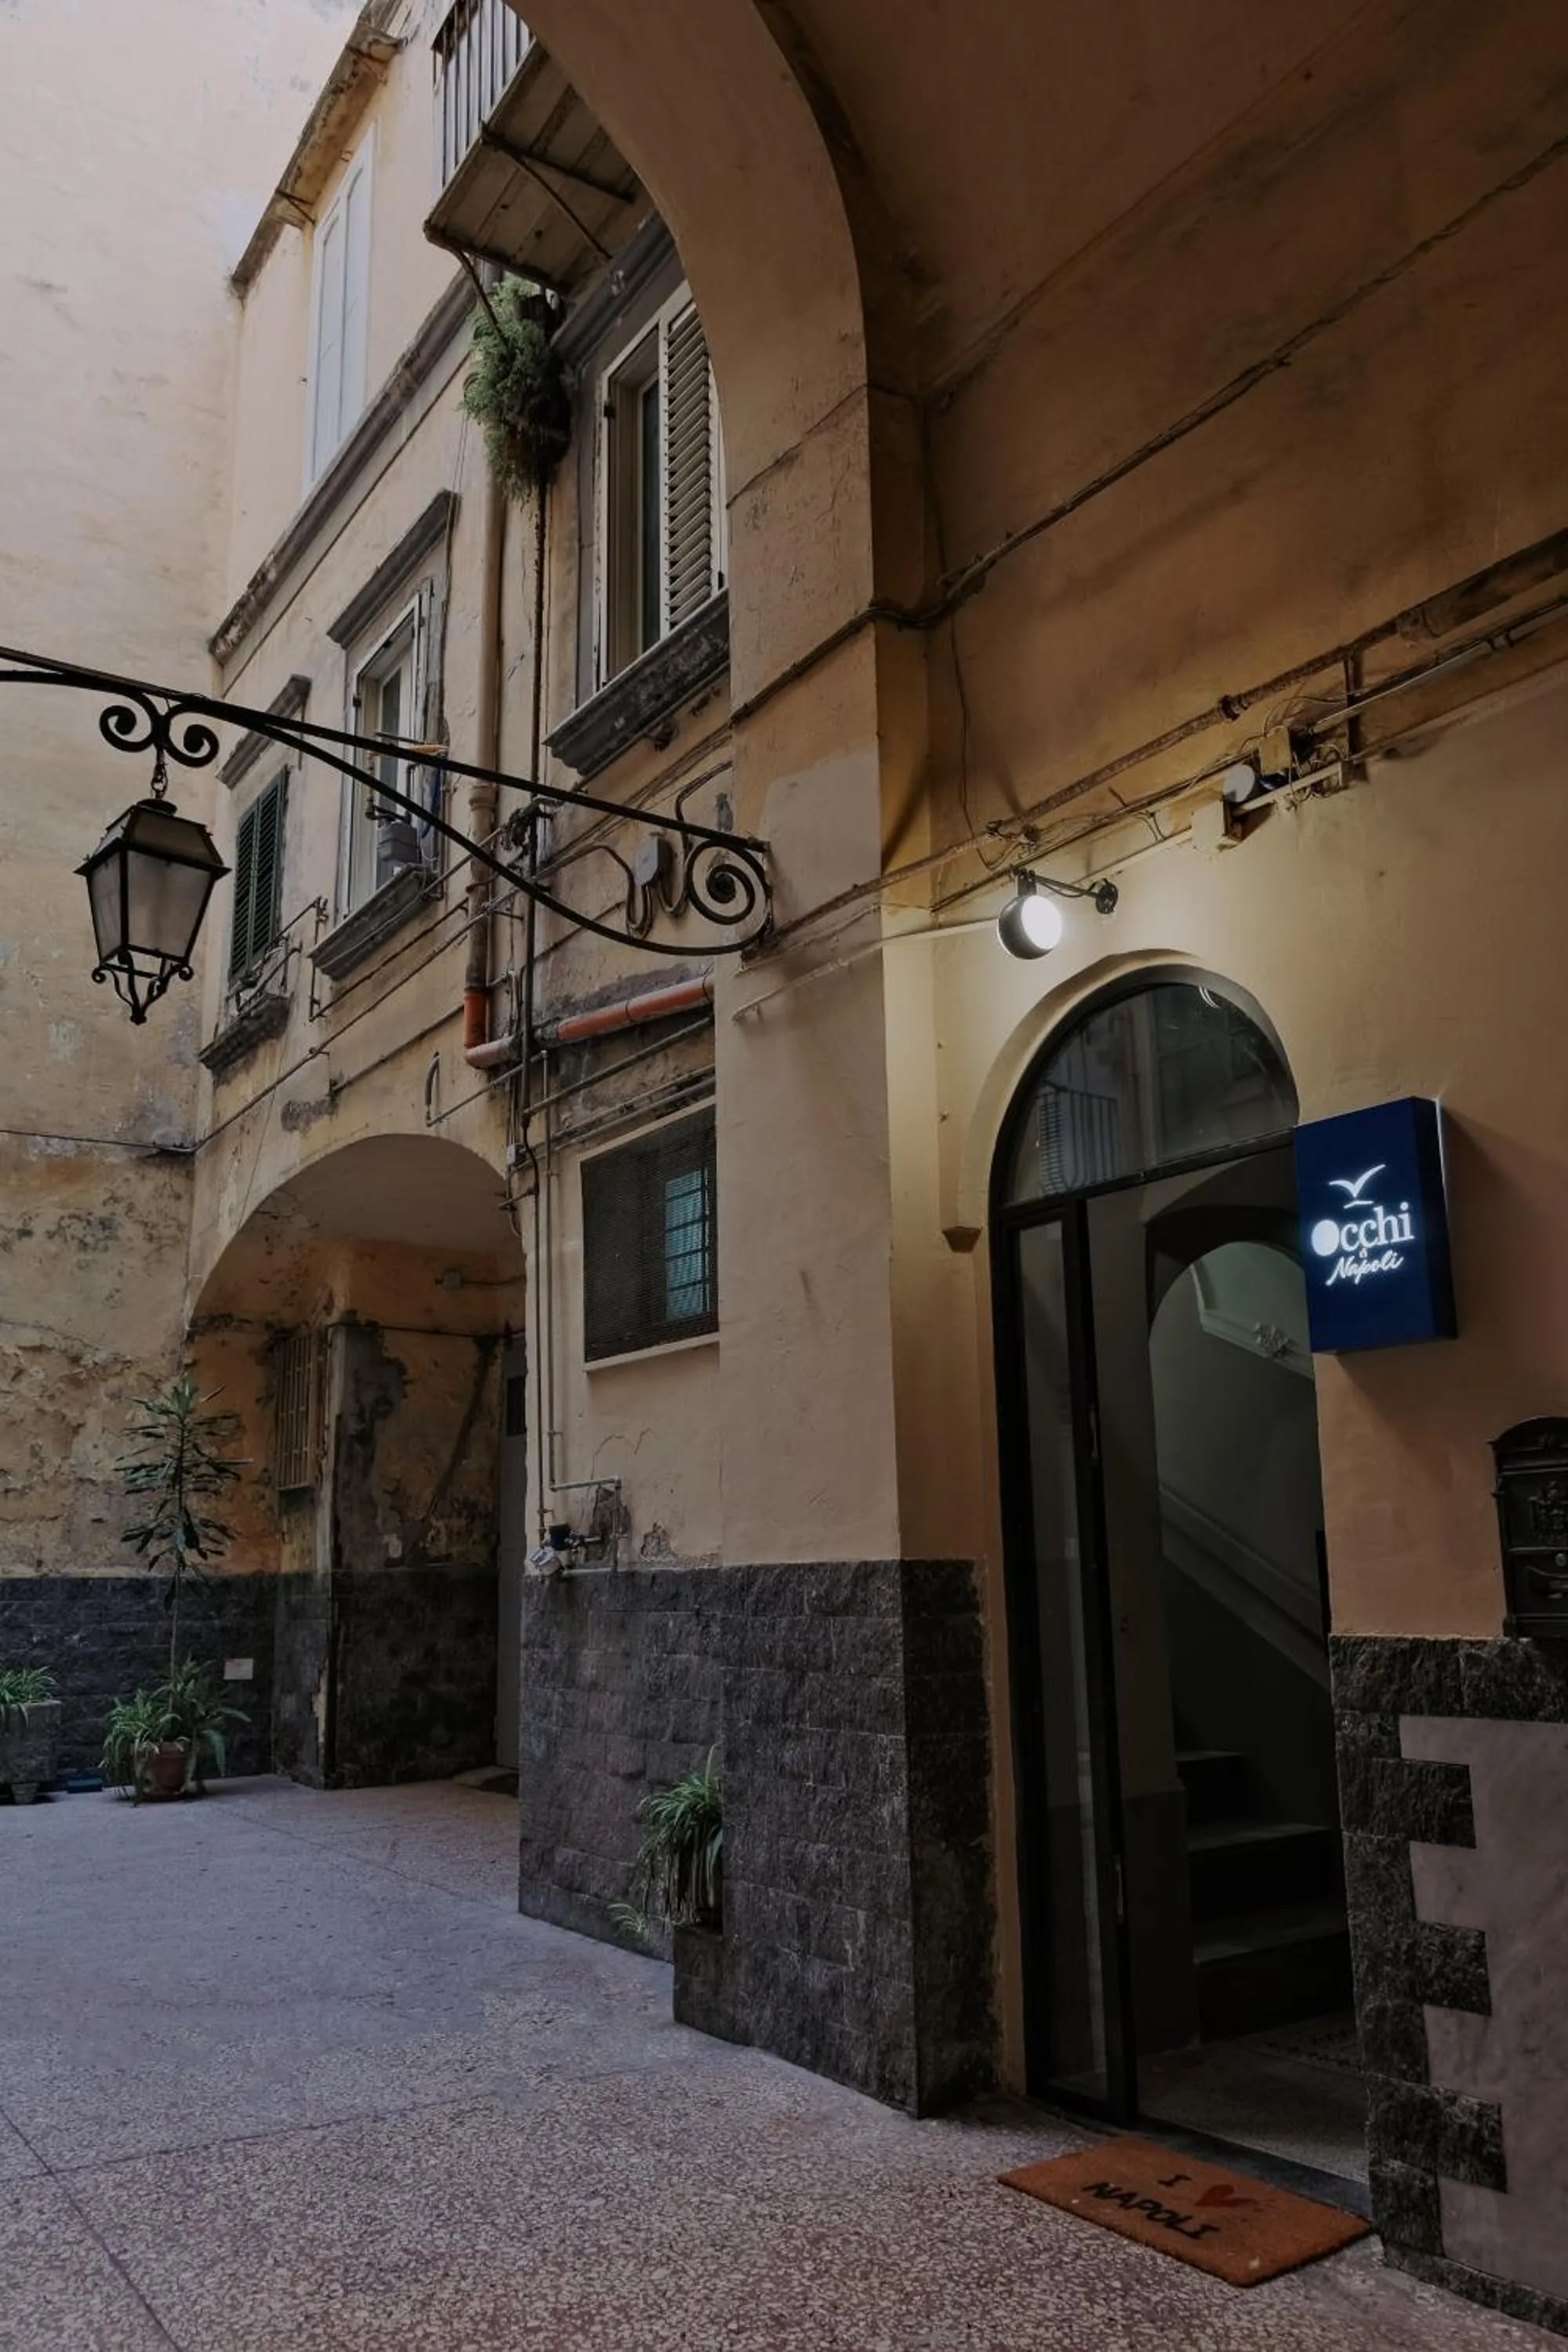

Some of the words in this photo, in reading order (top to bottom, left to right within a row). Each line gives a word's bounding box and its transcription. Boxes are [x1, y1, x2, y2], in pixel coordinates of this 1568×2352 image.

[1311, 1201, 1416, 1256] Occhi
[1325, 1249, 1405, 1286] Napoli
[1158, 2174, 1191, 2187] I
[1082, 2182, 1220, 2240] NAPOLI
